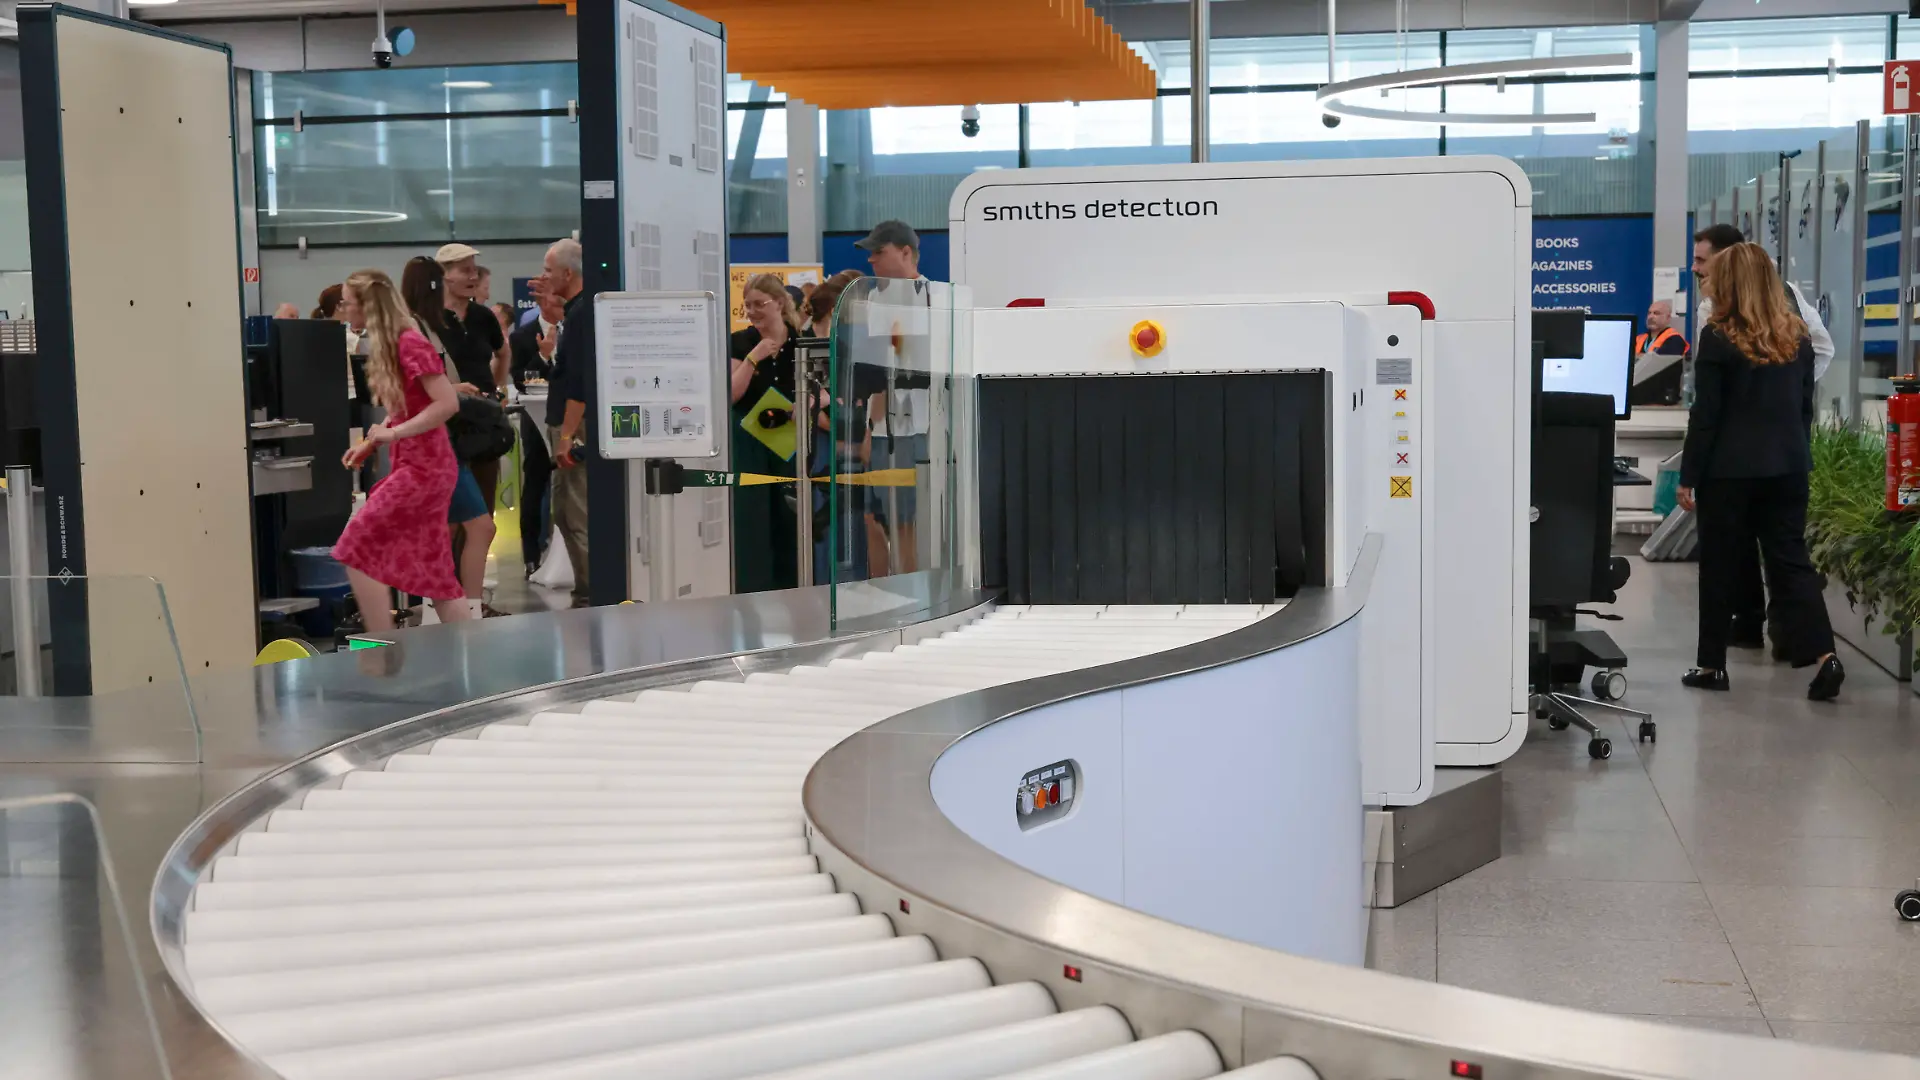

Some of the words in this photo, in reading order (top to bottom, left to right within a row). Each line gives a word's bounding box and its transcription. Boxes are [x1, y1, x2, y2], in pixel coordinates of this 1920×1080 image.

[983, 201, 1077, 221] smiths
[1084, 198, 1219, 219] detection
[1535, 238, 1579, 249] BOOKS
[1531, 260, 1593, 271] AGAZINES
[1532, 282, 1617, 294] ACCESSORIES
